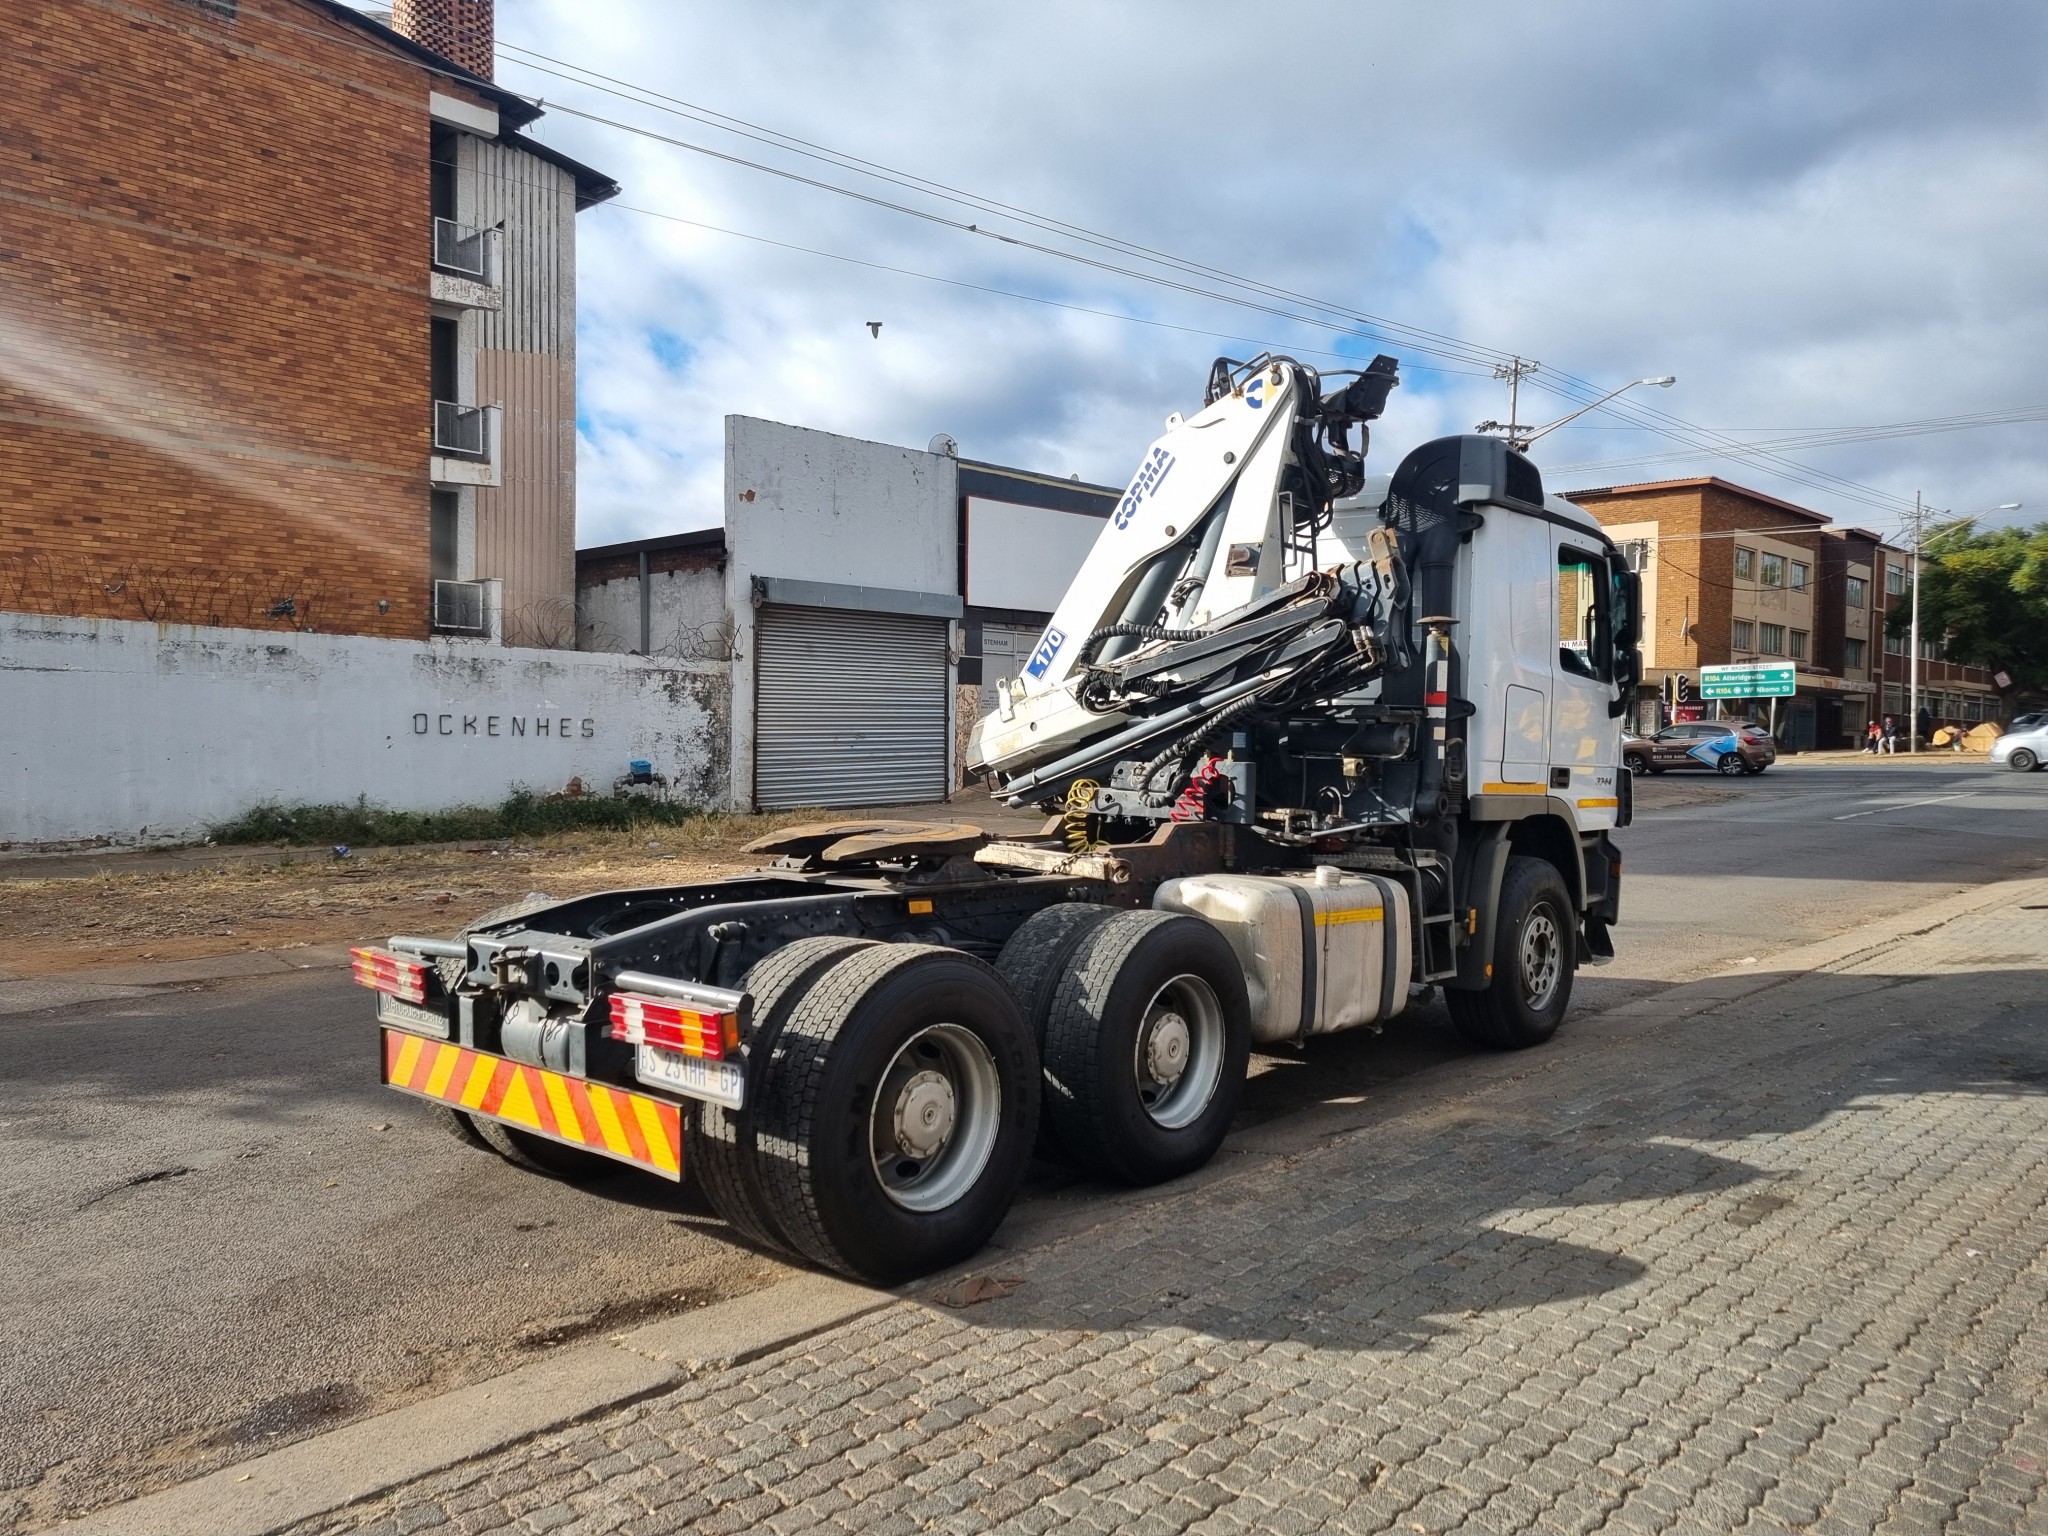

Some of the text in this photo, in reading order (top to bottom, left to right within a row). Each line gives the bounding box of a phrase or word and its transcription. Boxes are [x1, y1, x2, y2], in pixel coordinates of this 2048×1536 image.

[1115, 447, 1170, 530] COPMA
[984, 638, 1008, 647] STENHAM
[1036, 630, 1062, 666] 170
[1722, 673, 1766, 682] Atteridgeville
[1756, 685, 1780, 693] Nkomo
[413, 713, 594, 738] OCKENHES
[720, 1066, 739, 1094] GP
